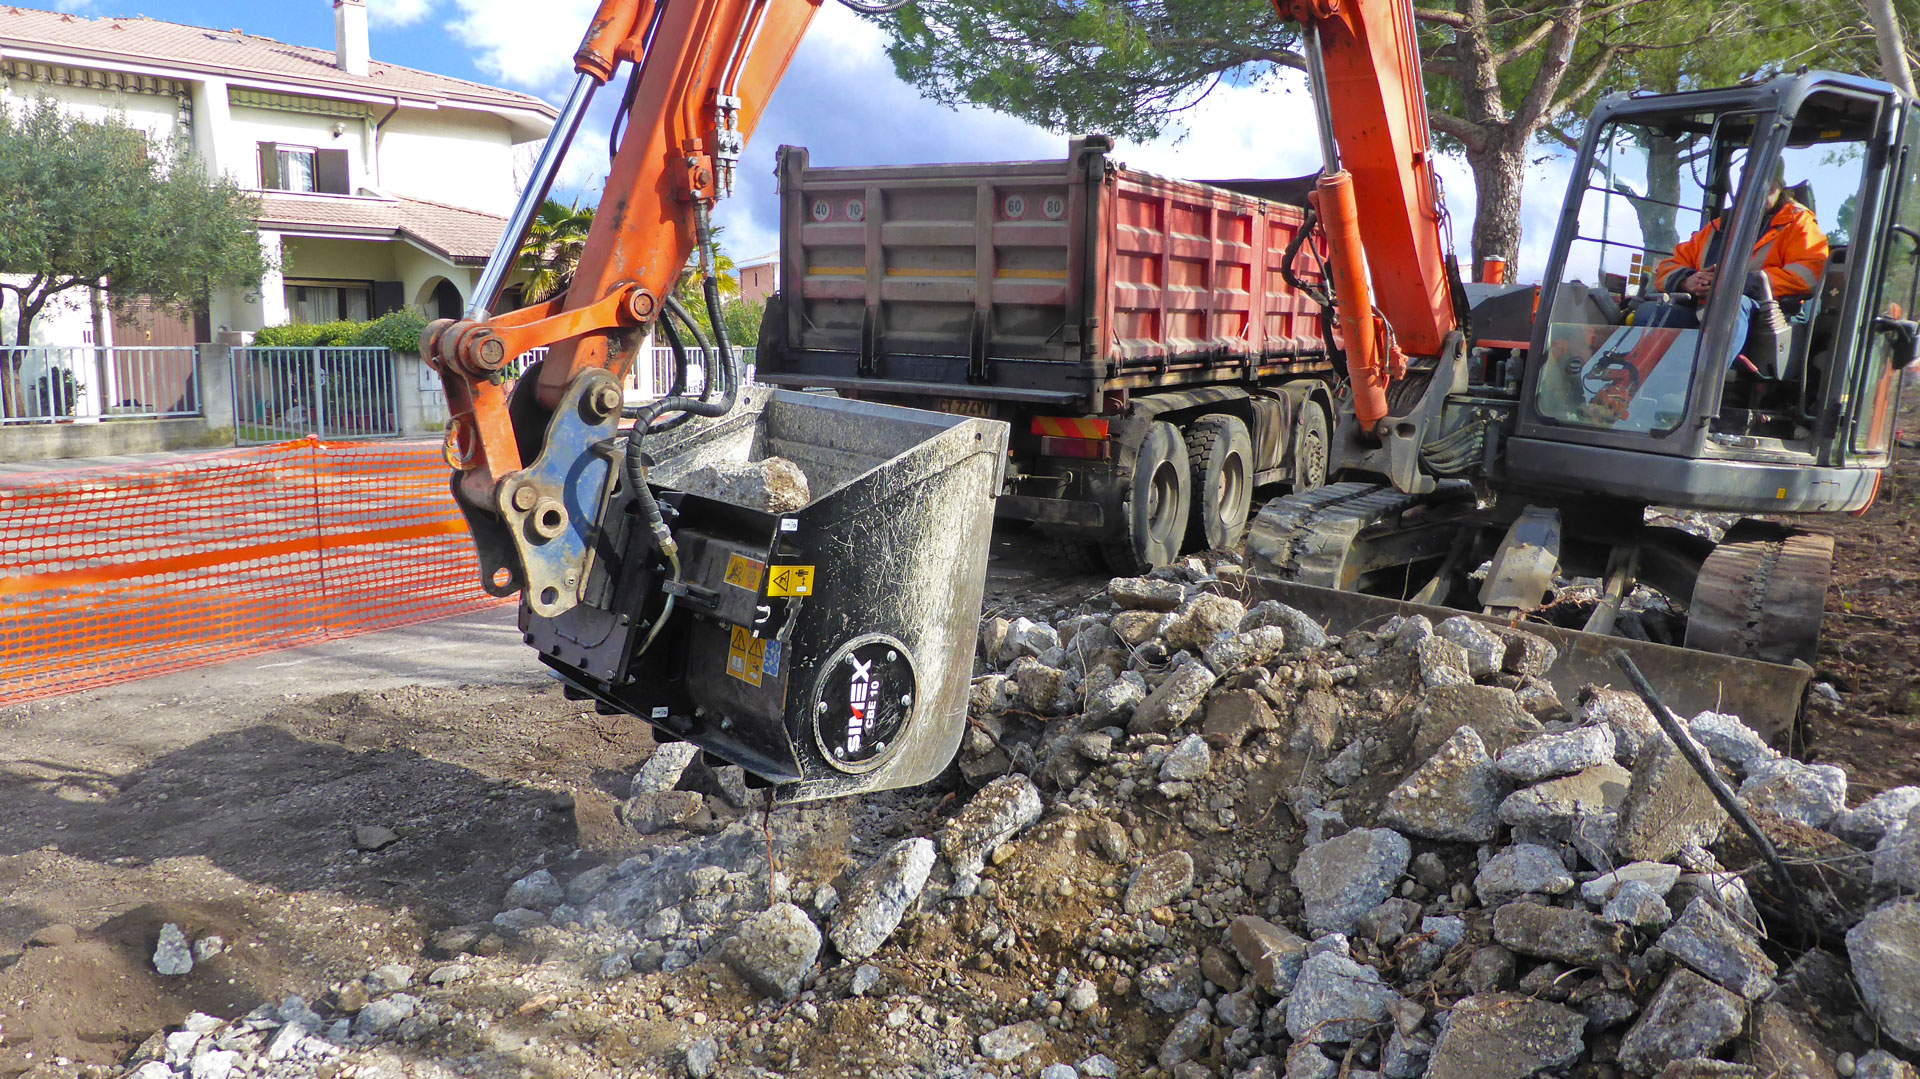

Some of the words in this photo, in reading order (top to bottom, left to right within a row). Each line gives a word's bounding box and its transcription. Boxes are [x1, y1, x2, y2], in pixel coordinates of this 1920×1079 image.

[815, 204, 827, 216] 40
[849, 204, 860, 216] 70
[1008, 200, 1021, 212] 60
[1047, 200, 1060, 213] 80
[870, 681, 880, 697] 10
[847, 656, 872, 753] SIMEX
[865, 701, 877, 729] CBE
